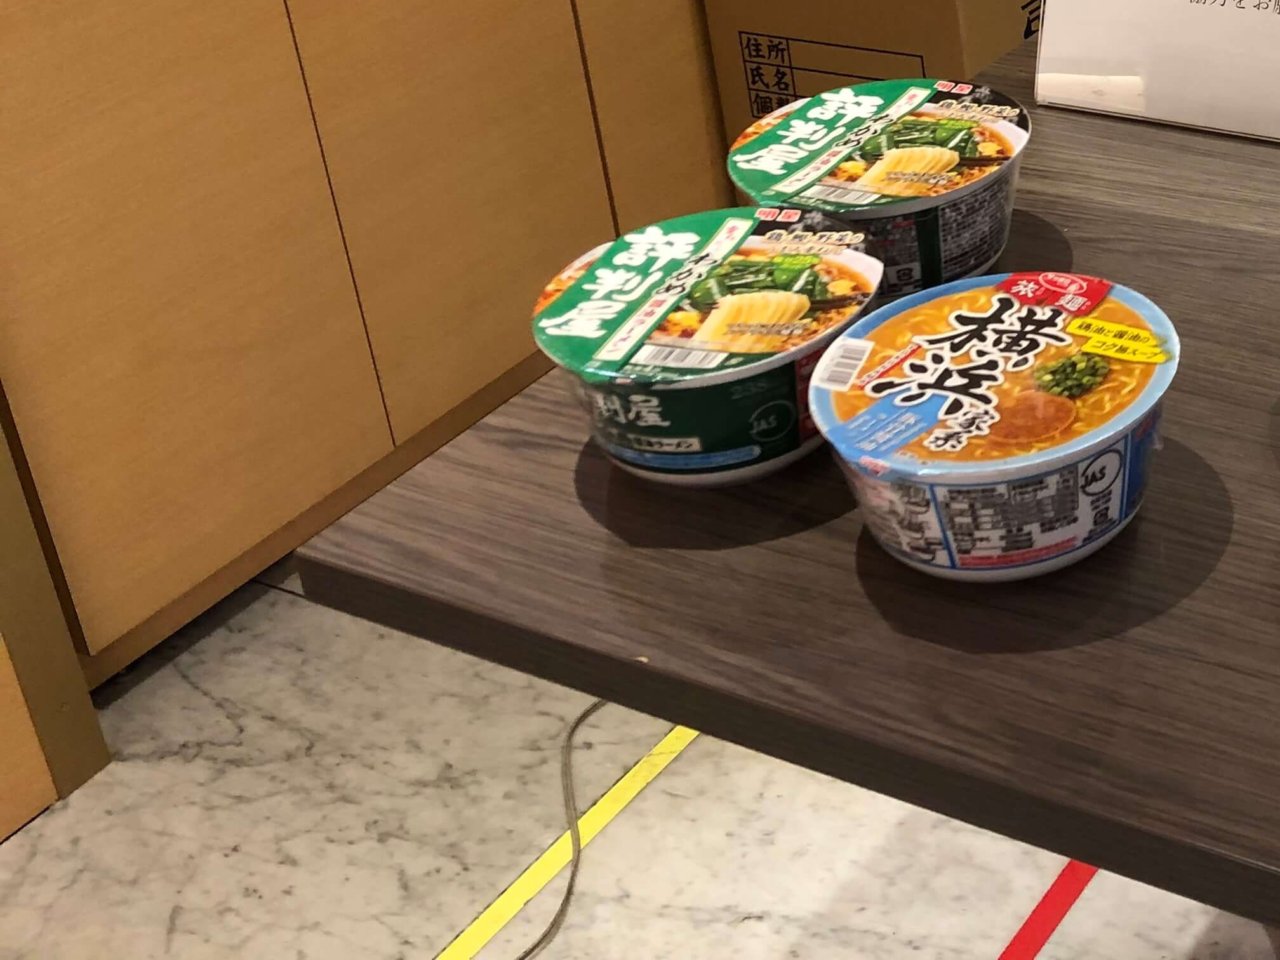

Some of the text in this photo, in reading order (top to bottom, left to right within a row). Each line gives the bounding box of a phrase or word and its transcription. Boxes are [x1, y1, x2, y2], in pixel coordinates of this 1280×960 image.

[744, 36, 786, 64] 住所
[750, 64, 790, 91] 氏名
[834, 113, 895, 148] わかめ
[655, 252, 719, 297] わかめ
[1081, 466, 1106, 490] JAS
